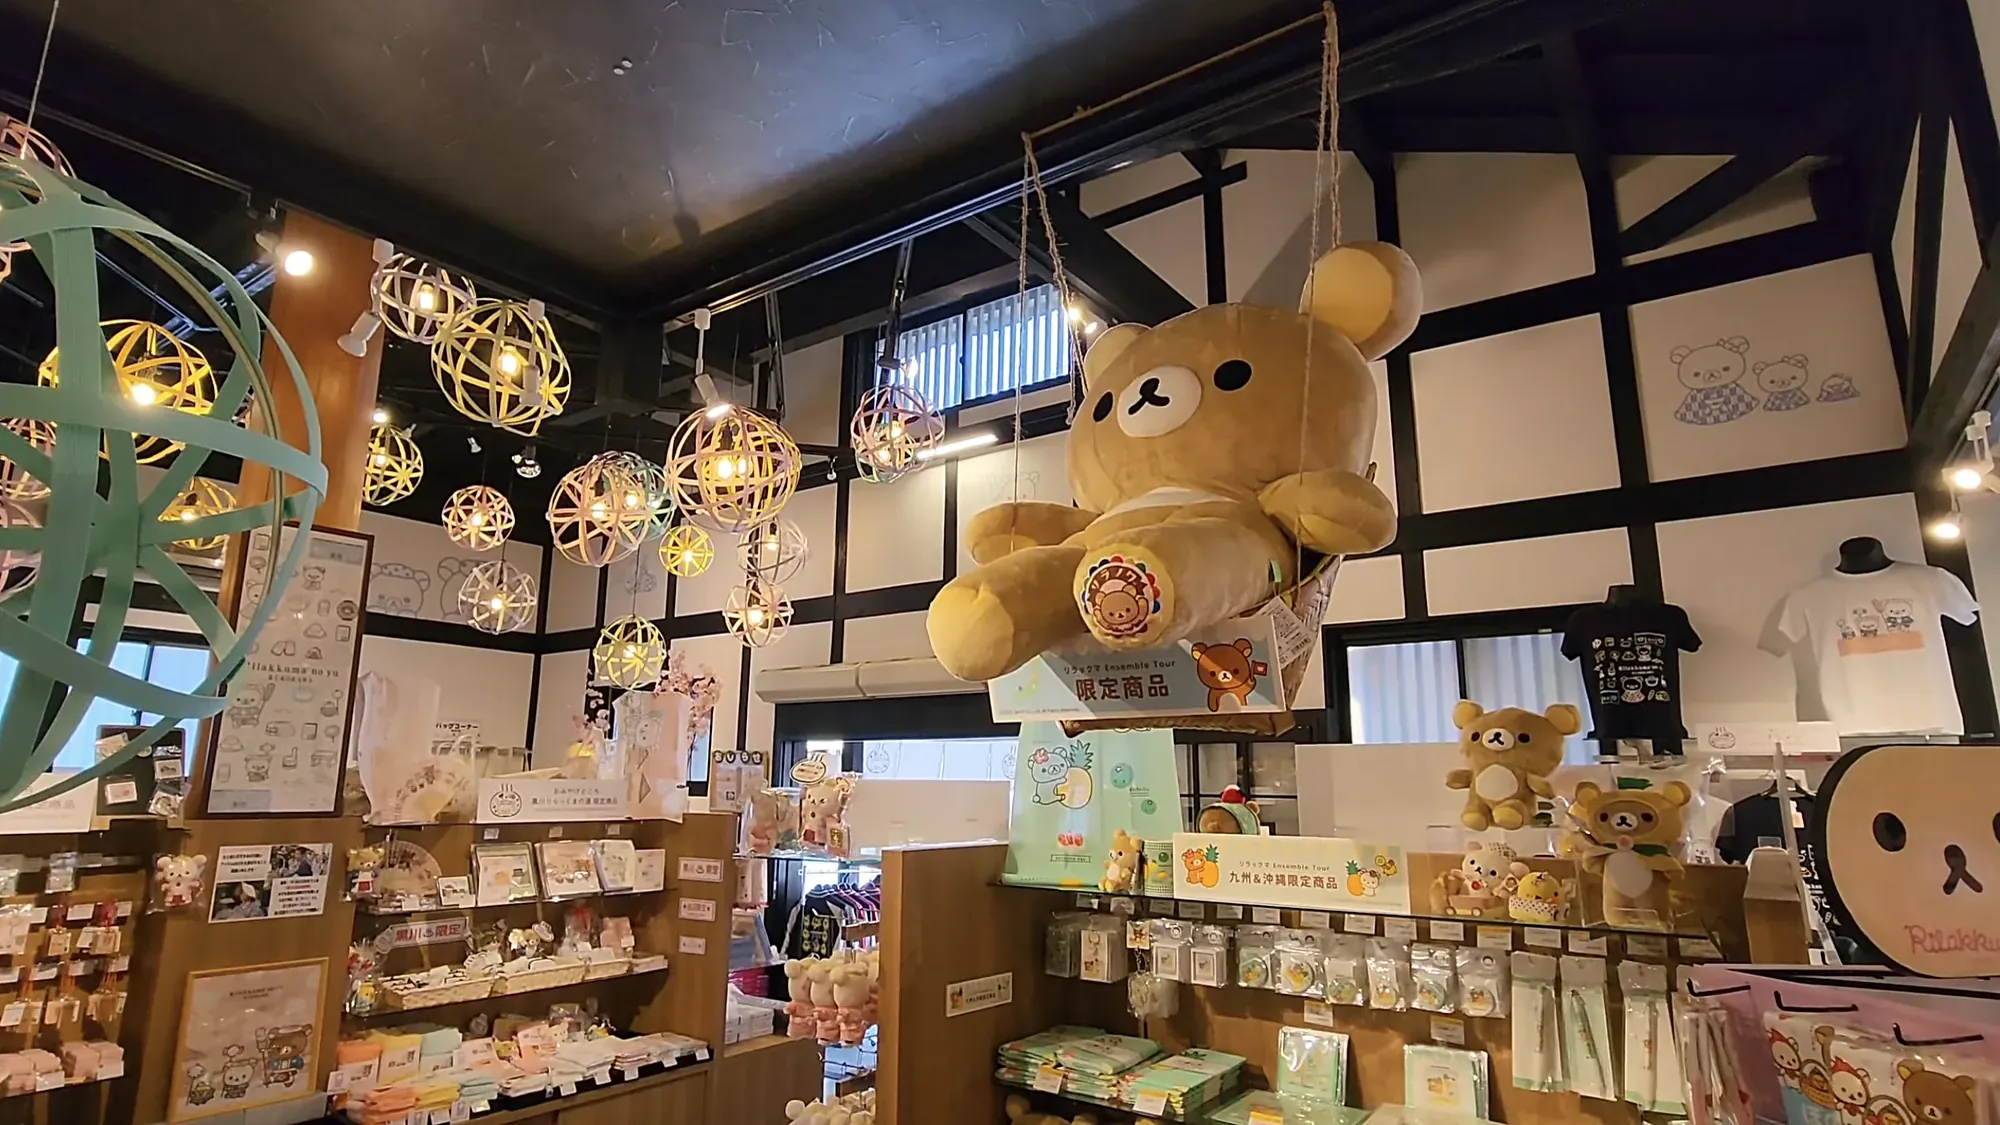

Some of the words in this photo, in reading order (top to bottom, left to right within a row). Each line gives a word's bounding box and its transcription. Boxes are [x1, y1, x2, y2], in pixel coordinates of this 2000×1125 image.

[1105, 660, 1149, 672] Ensemble
[1153, 660, 1175, 668] Tour
[1075, 673, 1170, 701] 限定商品
[1273, 862, 1309, 870] Ensemble
[1228, 870, 1339, 890] 九州&沖縄限定商品
[435, 923, 461, 938] 限定
